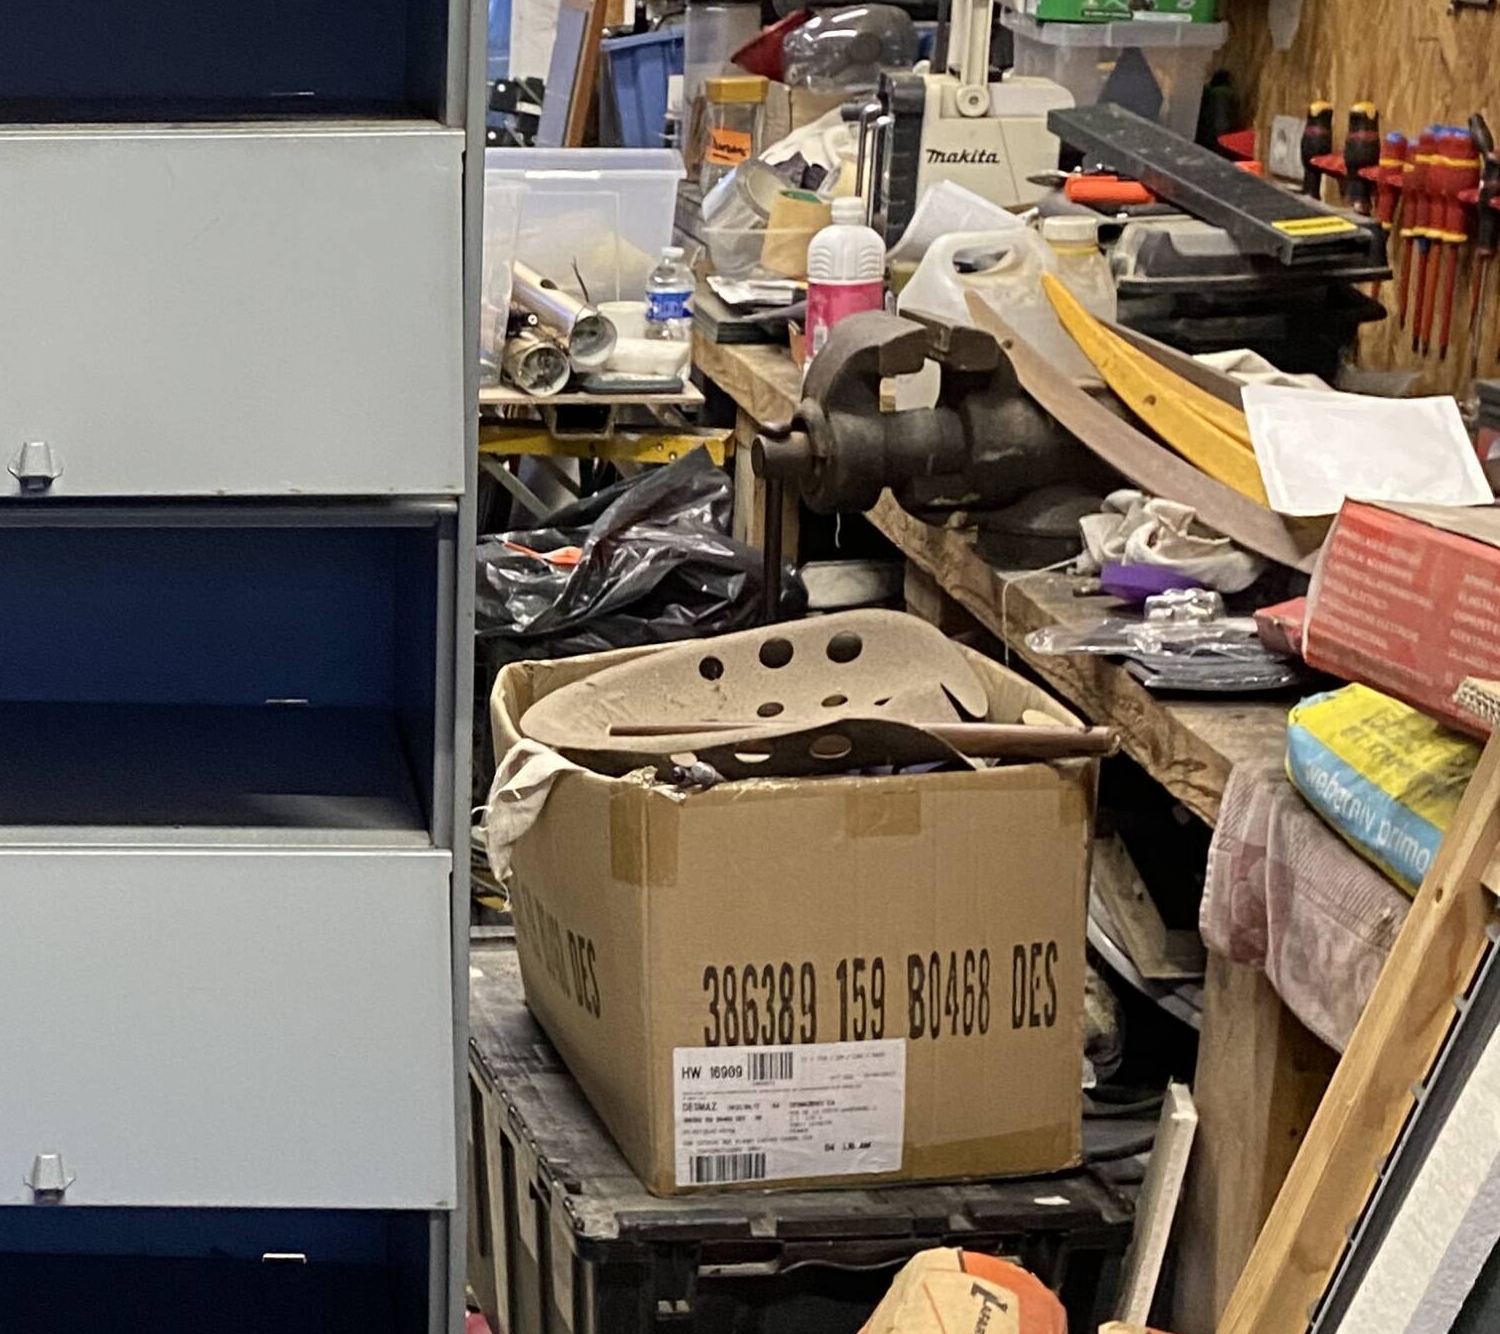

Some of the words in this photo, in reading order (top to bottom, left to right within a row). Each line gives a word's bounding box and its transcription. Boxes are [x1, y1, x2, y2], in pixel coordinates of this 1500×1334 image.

[1377, 817, 1432, 875] primo
[566, 928, 602, 1020] DES
[703, 961, 818, 1047] 386389
[836, 956, 886, 1042] 159
[906, 948, 991, 1040] B0468
[1011, 940, 1059, 1030] DES
[681, 1065, 702, 1080] HW
